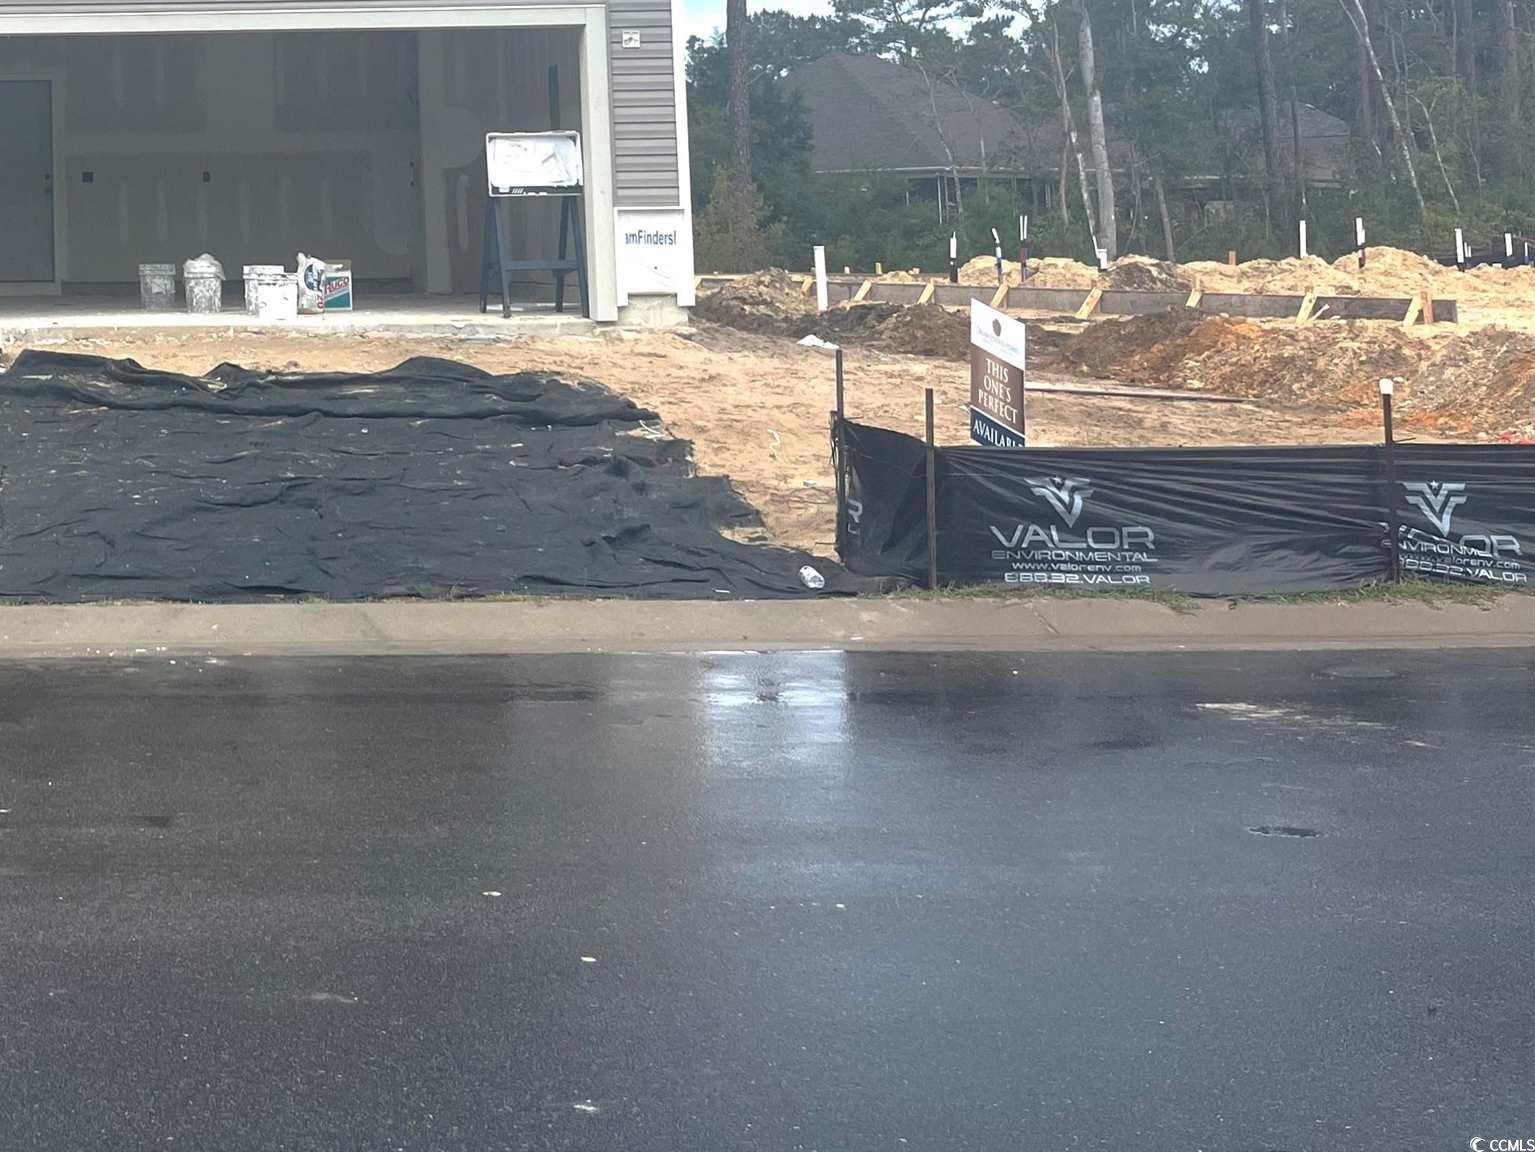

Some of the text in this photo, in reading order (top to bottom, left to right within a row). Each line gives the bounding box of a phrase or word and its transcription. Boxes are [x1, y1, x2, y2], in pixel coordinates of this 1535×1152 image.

[985, 358, 1009, 383] THIS
[983, 376, 1011, 403] ONE'S
[978, 389, 1018, 425] PERFECT
[989, 524, 1156, 549] VALOR
[991, 550, 1159, 562] ENVIRONMENTAL
[1011, 562, 1142, 572] www.valorenv.com
